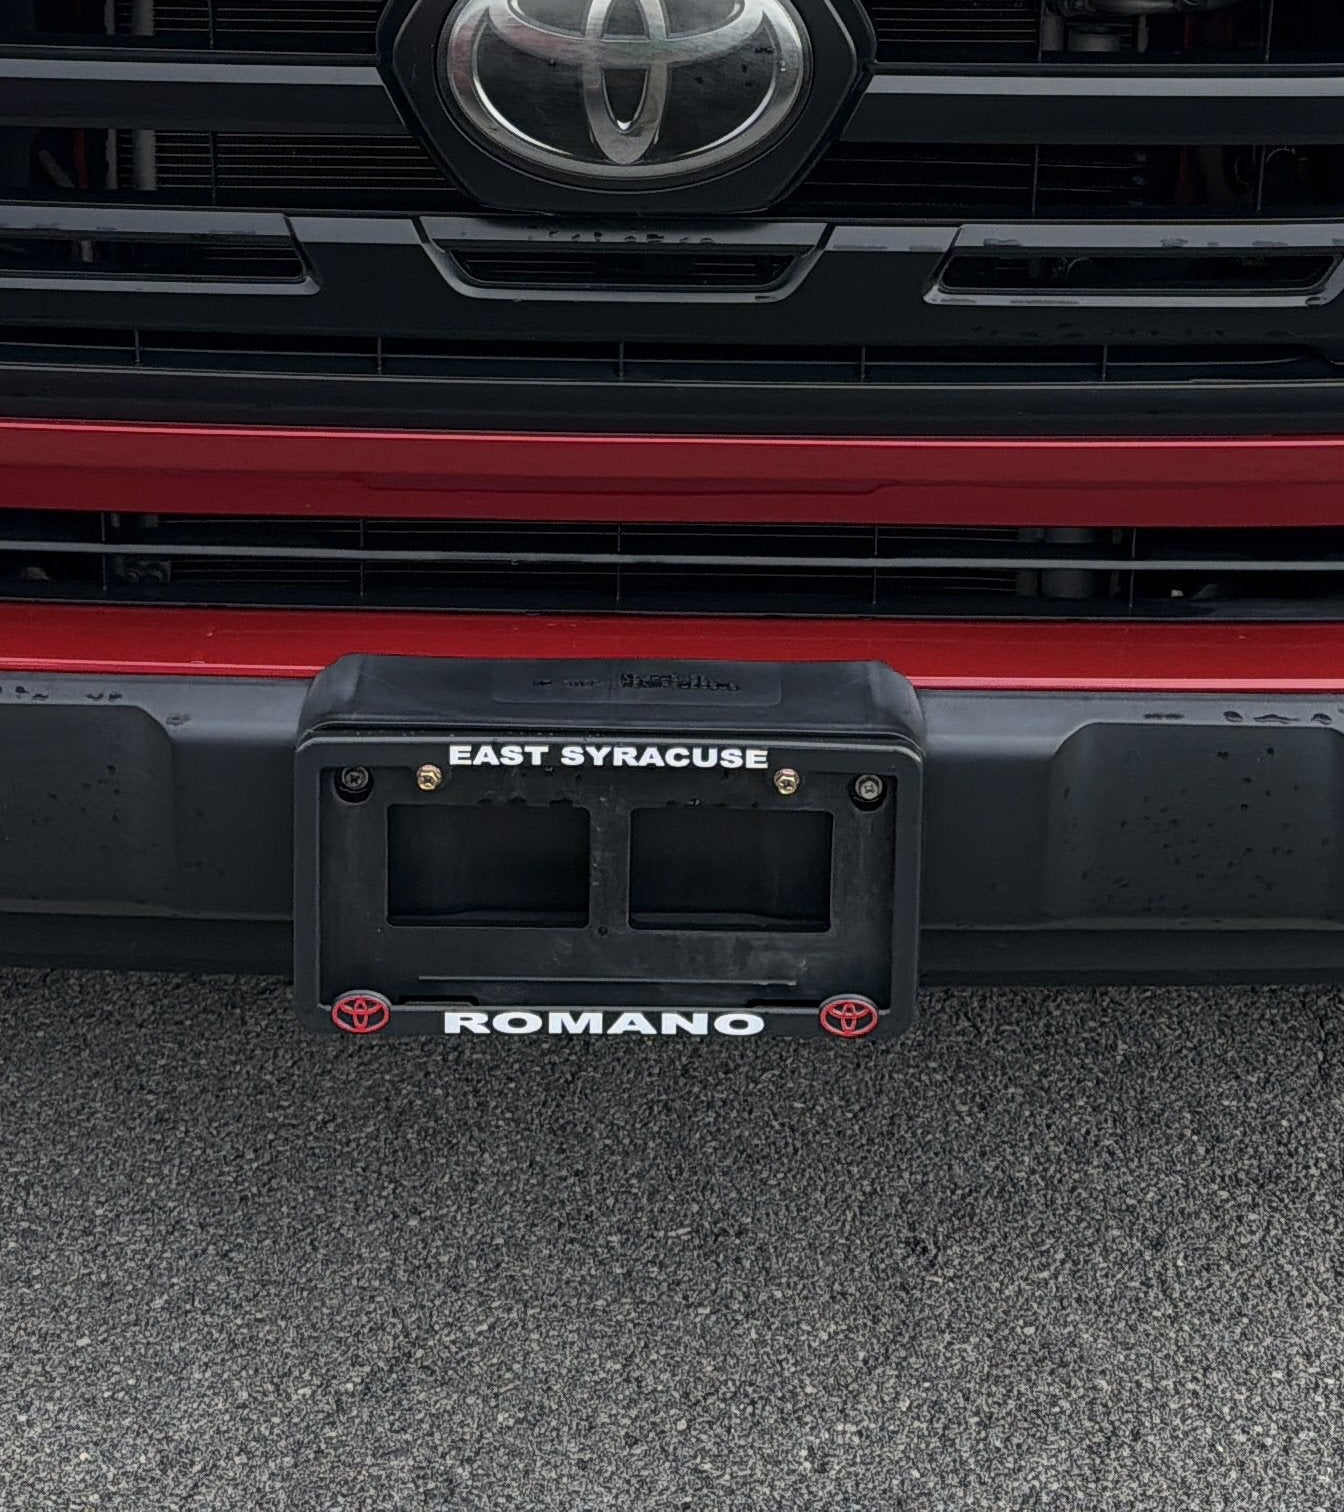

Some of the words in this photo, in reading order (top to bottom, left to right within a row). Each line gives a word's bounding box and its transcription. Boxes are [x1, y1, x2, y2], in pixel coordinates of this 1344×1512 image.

[449, 744, 550, 766] EAST
[560, 745, 769, 769] SYRACUSE
[444, 1011, 765, 1036] ROMANO
